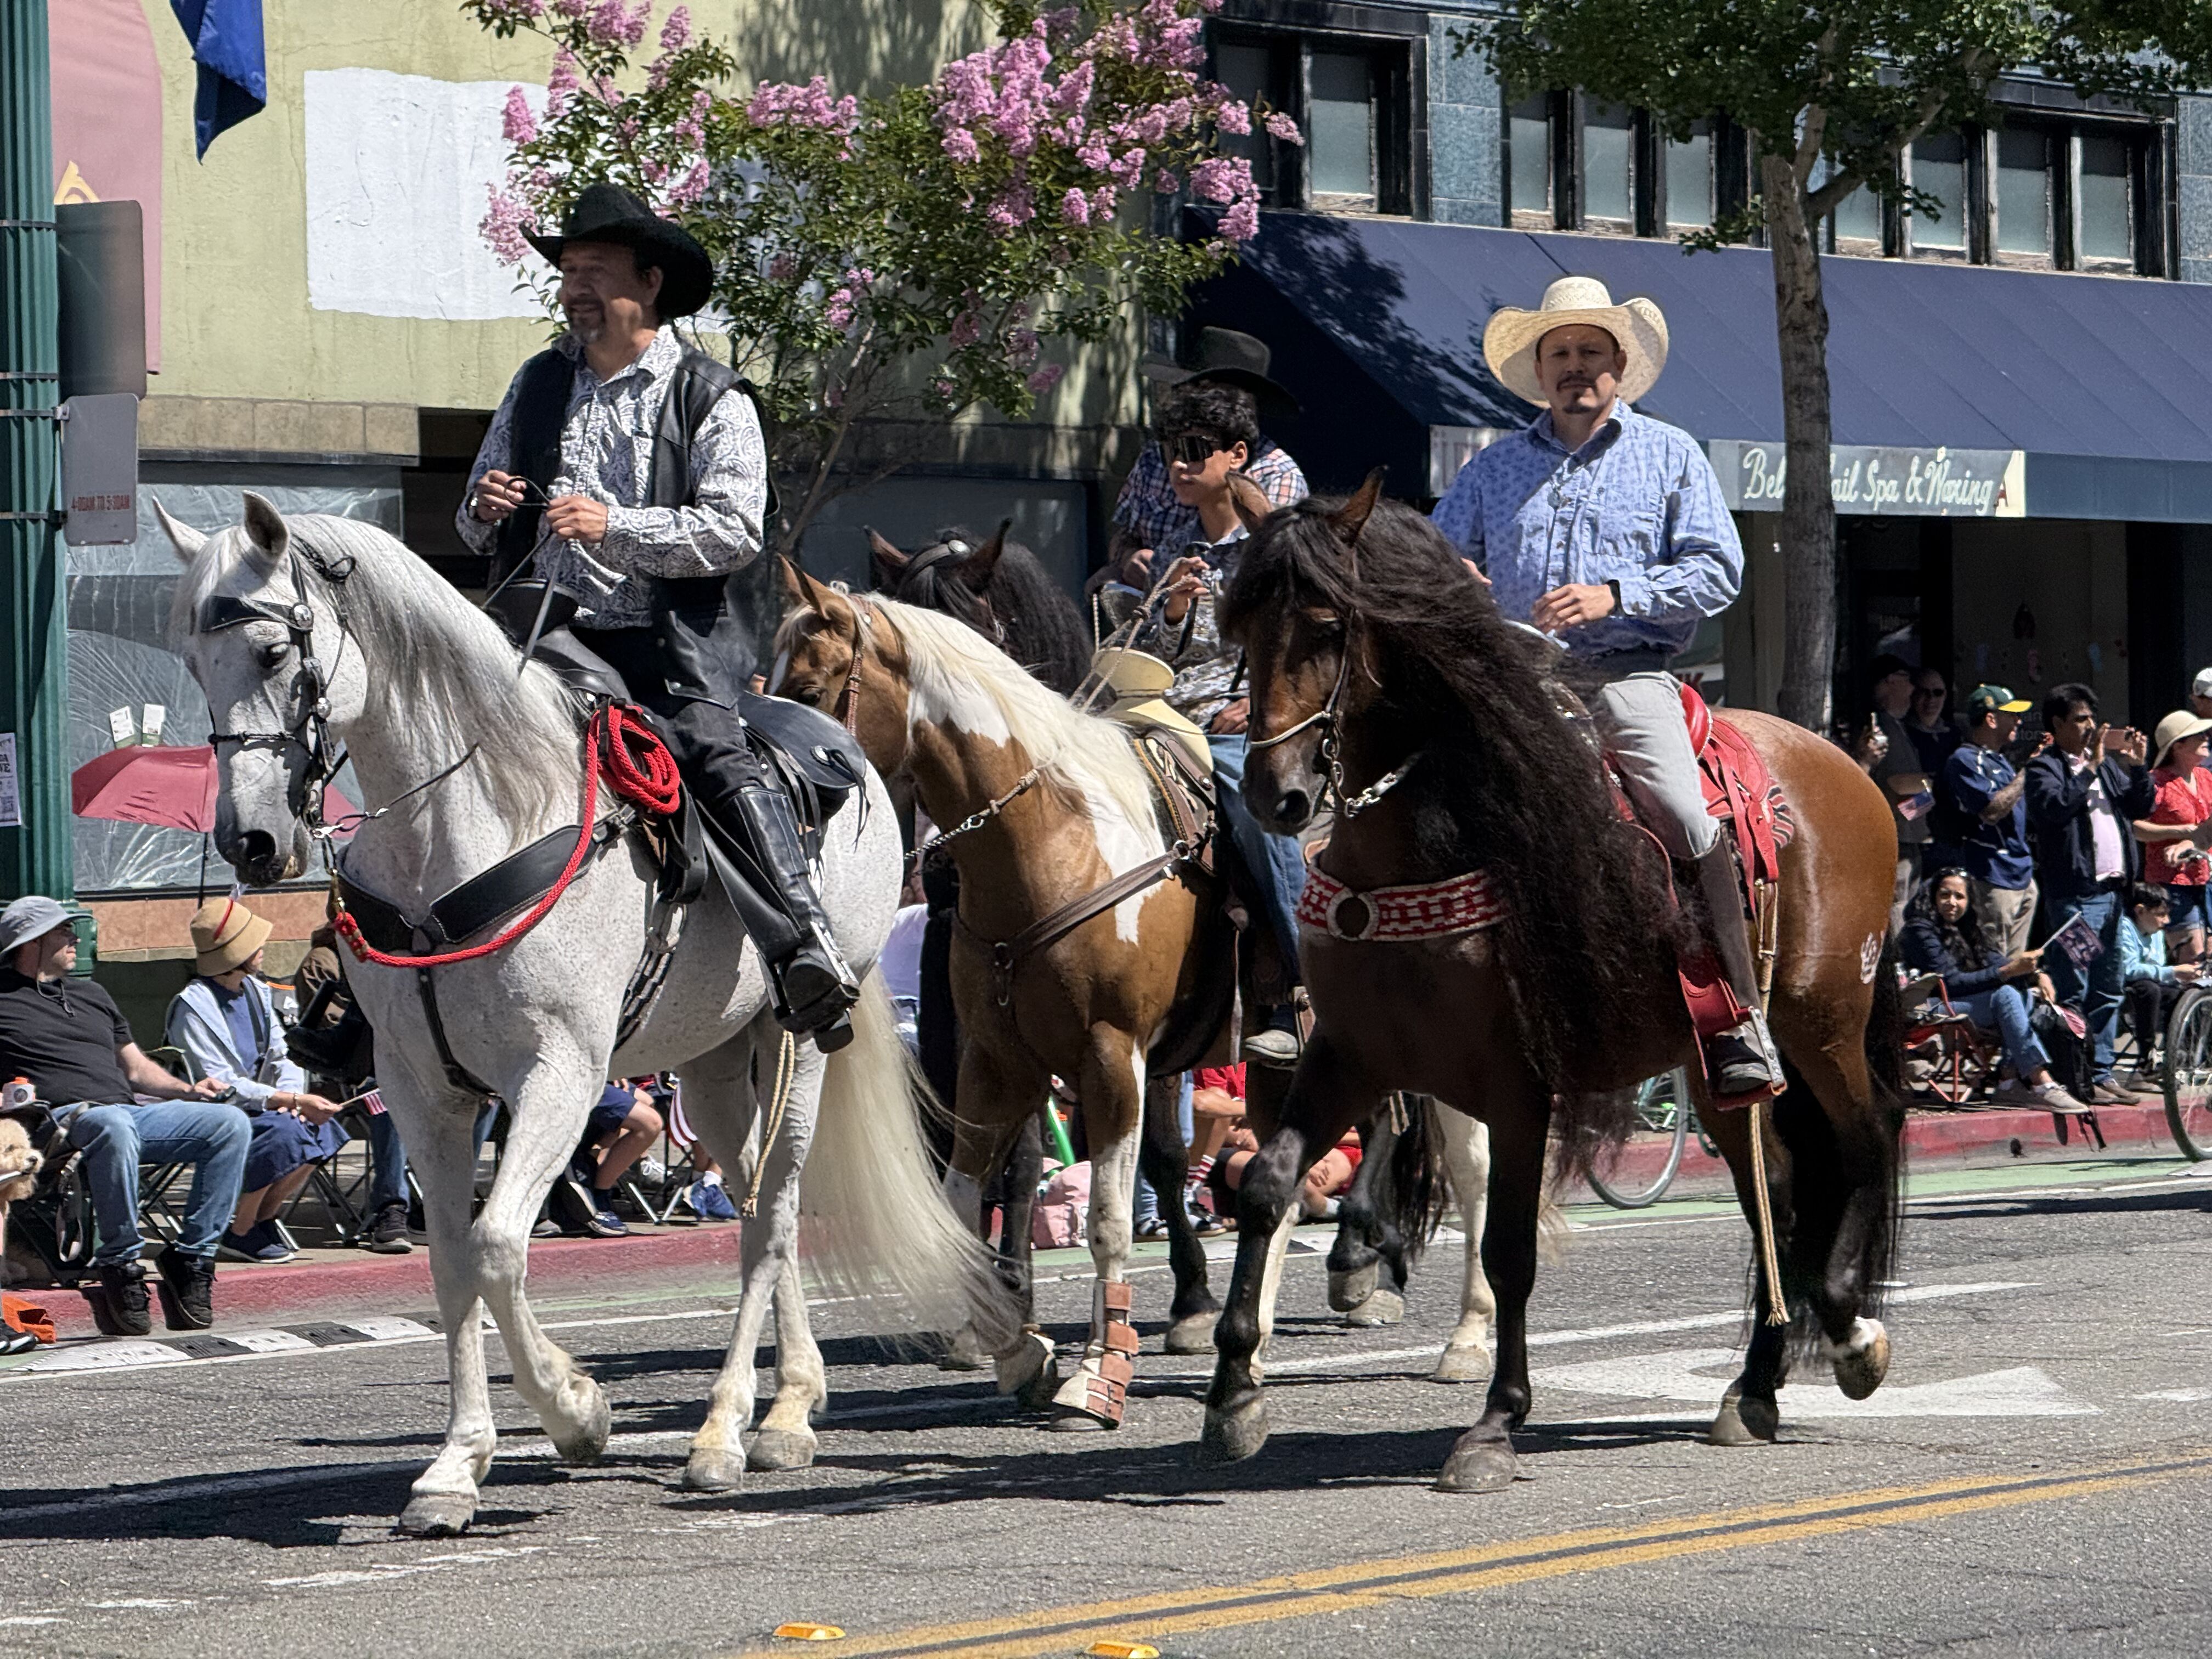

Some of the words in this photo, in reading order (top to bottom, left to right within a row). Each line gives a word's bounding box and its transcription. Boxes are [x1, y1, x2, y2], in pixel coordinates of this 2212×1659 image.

[97, 495, 105, 510] TO
[1743, 448, 1786, 499] Bel
[1863, 459, 1899, 511] Spa
[1905, 455, 1923, 503] &
[1924, 460, 1994, 516] Waxing
